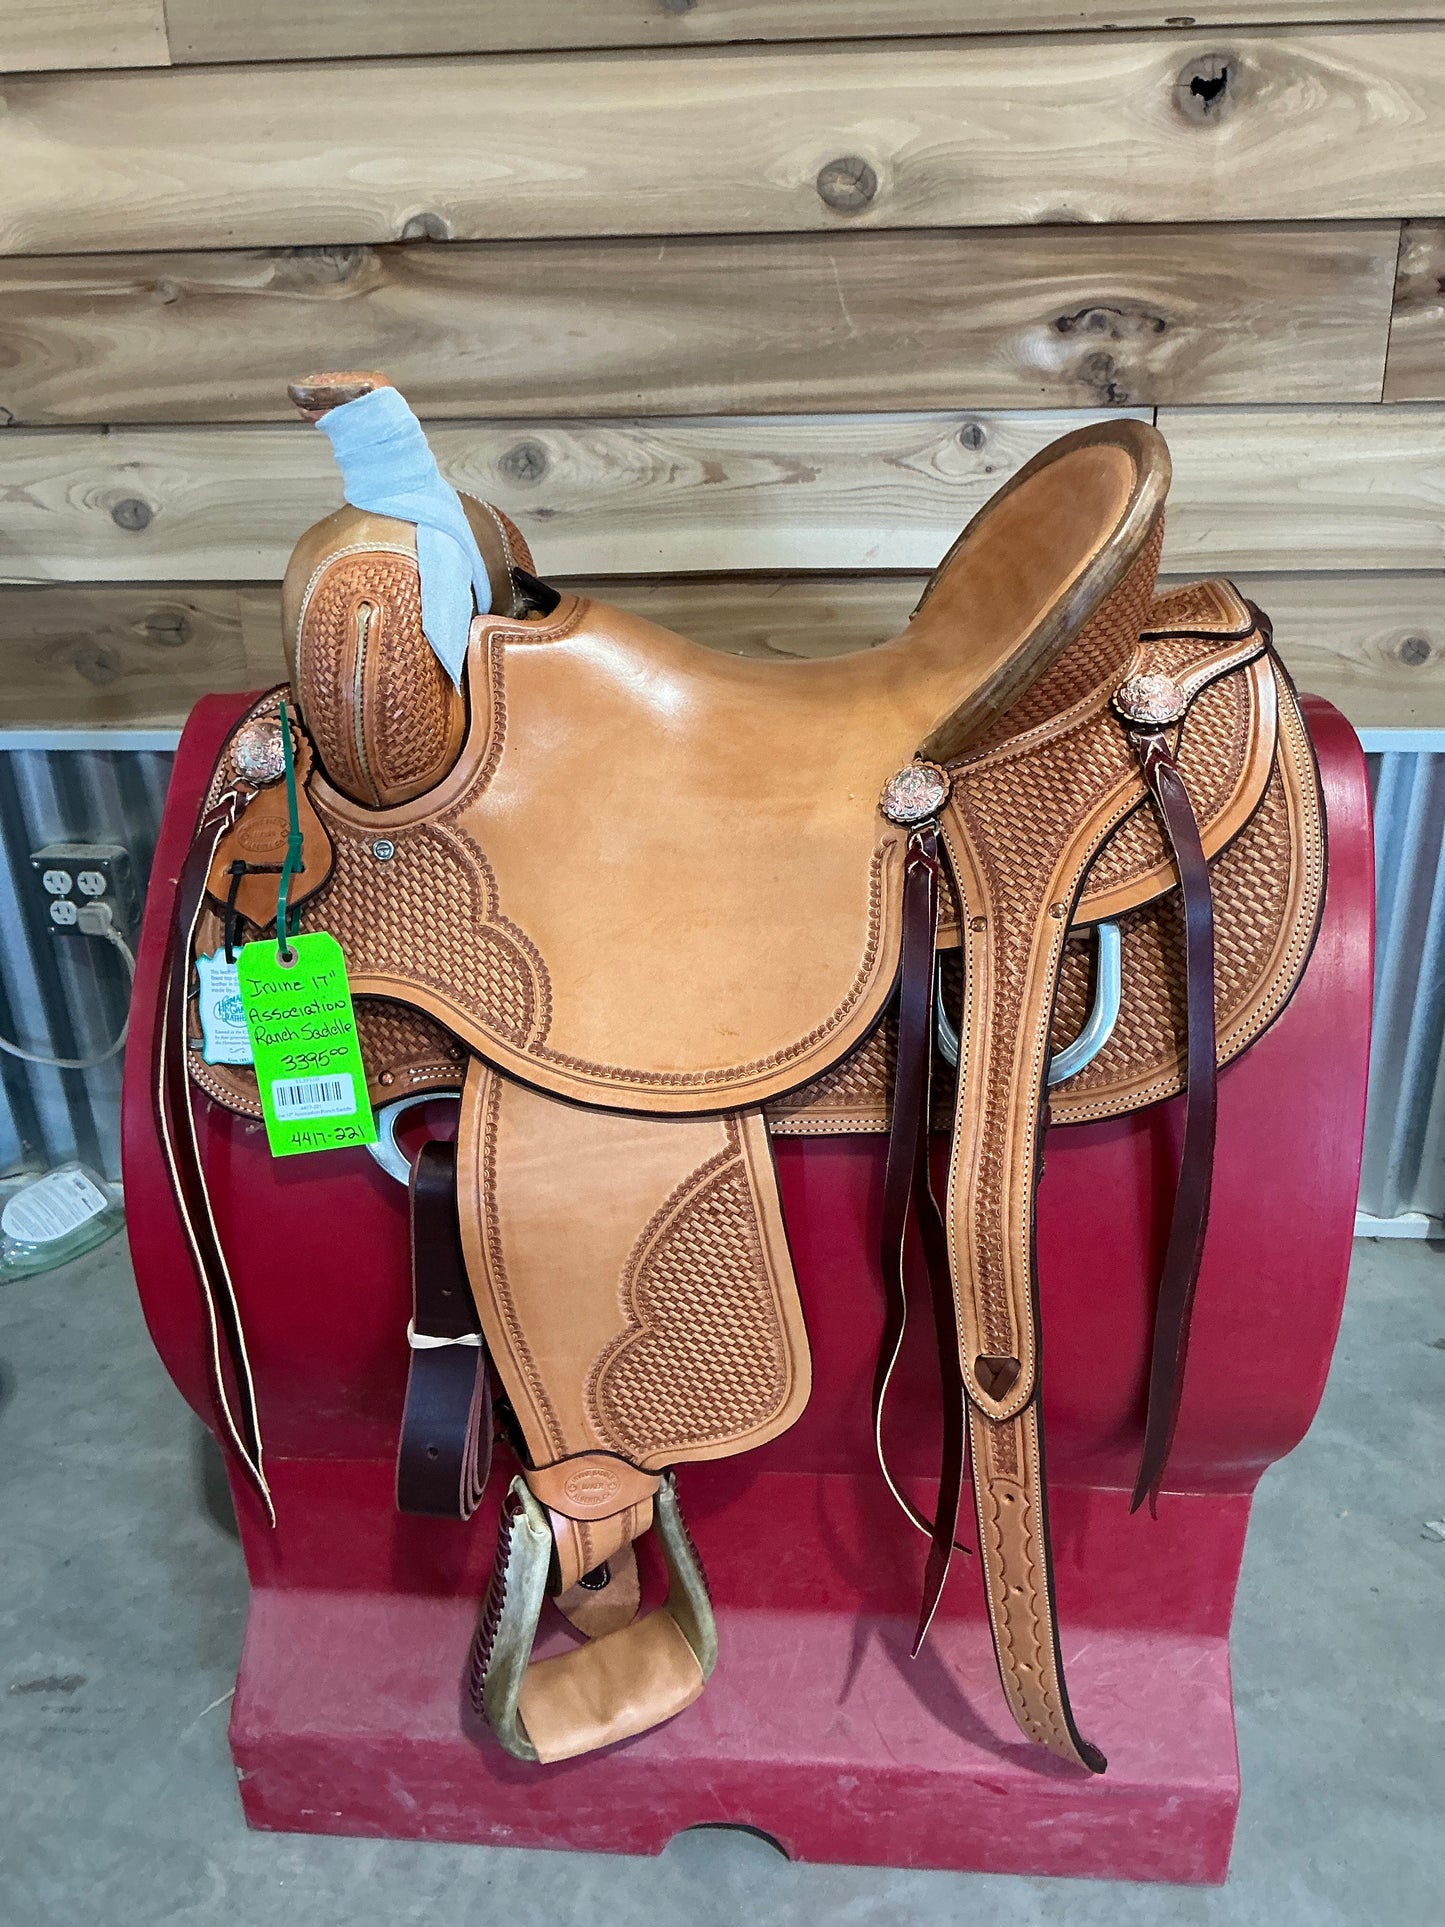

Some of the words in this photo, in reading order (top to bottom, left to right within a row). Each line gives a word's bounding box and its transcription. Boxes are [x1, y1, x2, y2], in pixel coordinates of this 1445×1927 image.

[246, 978, 304, 997] Irvine
[249, 996, 346, 1024] Association
[254, 1026, 300, 1046] Ranch
[301, 1018, 352, 1040] Saddle
[291, 1124, 365, 1146] 4417-221
